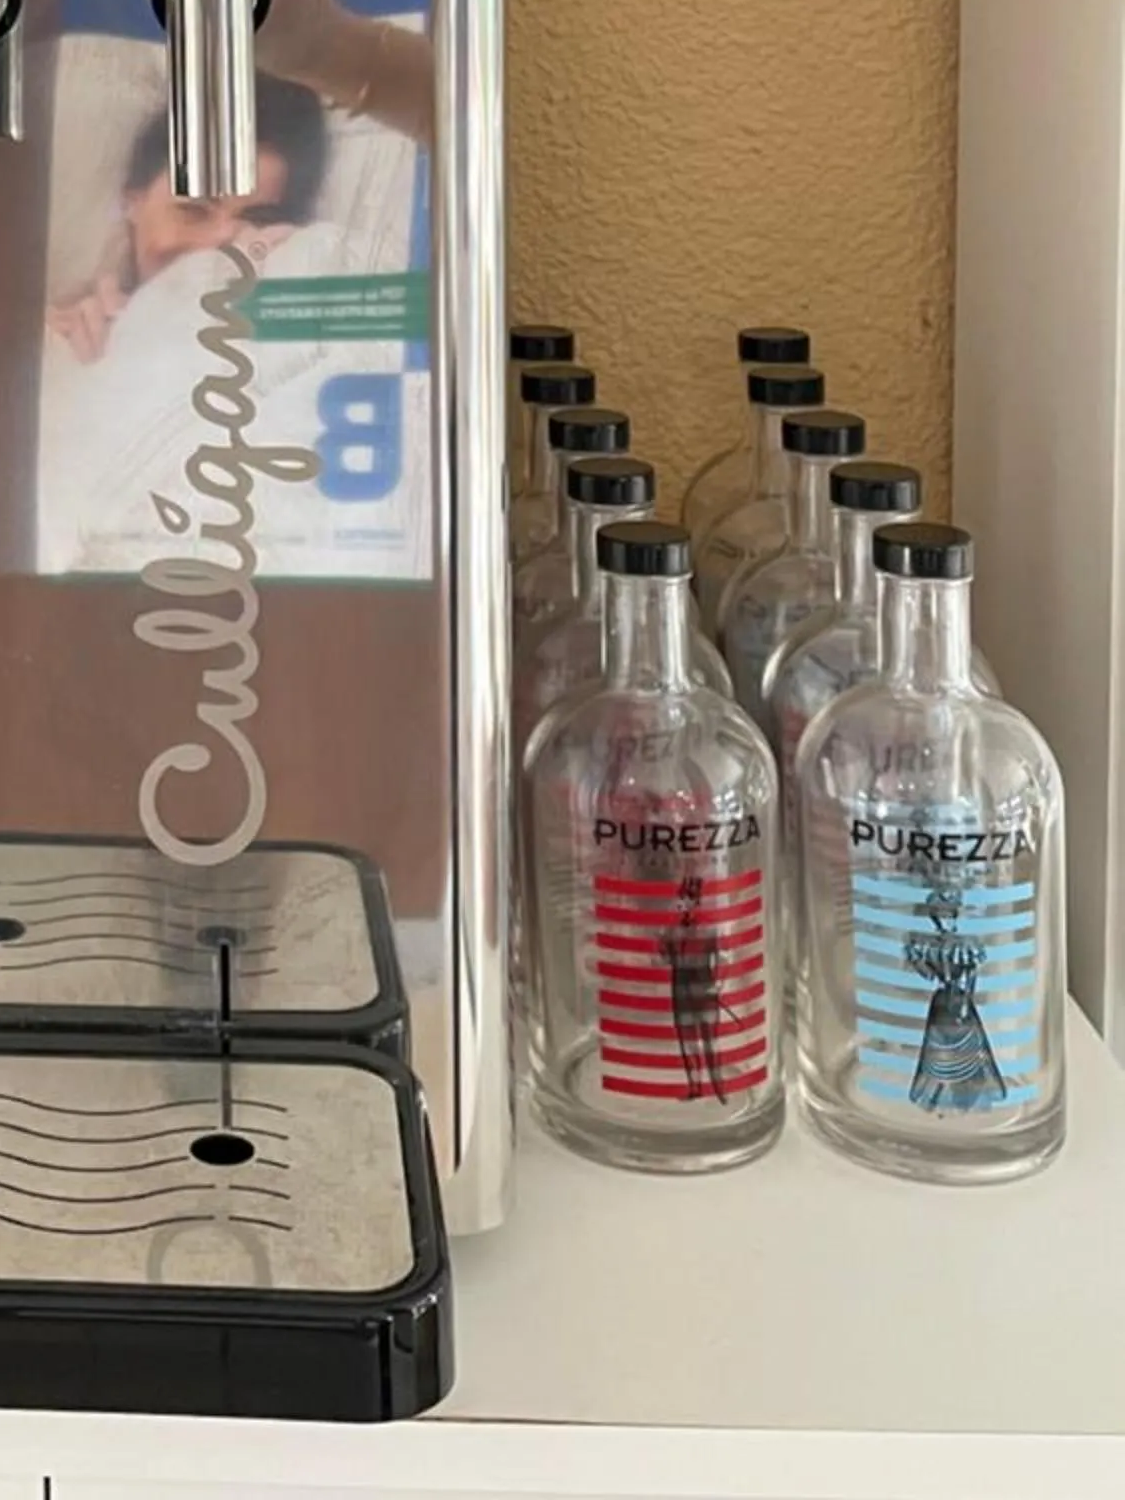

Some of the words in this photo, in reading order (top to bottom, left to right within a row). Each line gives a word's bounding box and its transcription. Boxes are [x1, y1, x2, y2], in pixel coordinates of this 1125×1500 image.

[133, 243, 322, 867] Culligan
[593, 813, 762, 854] PUREZZA
[850, 818, 1033, 863] PUREZZA
